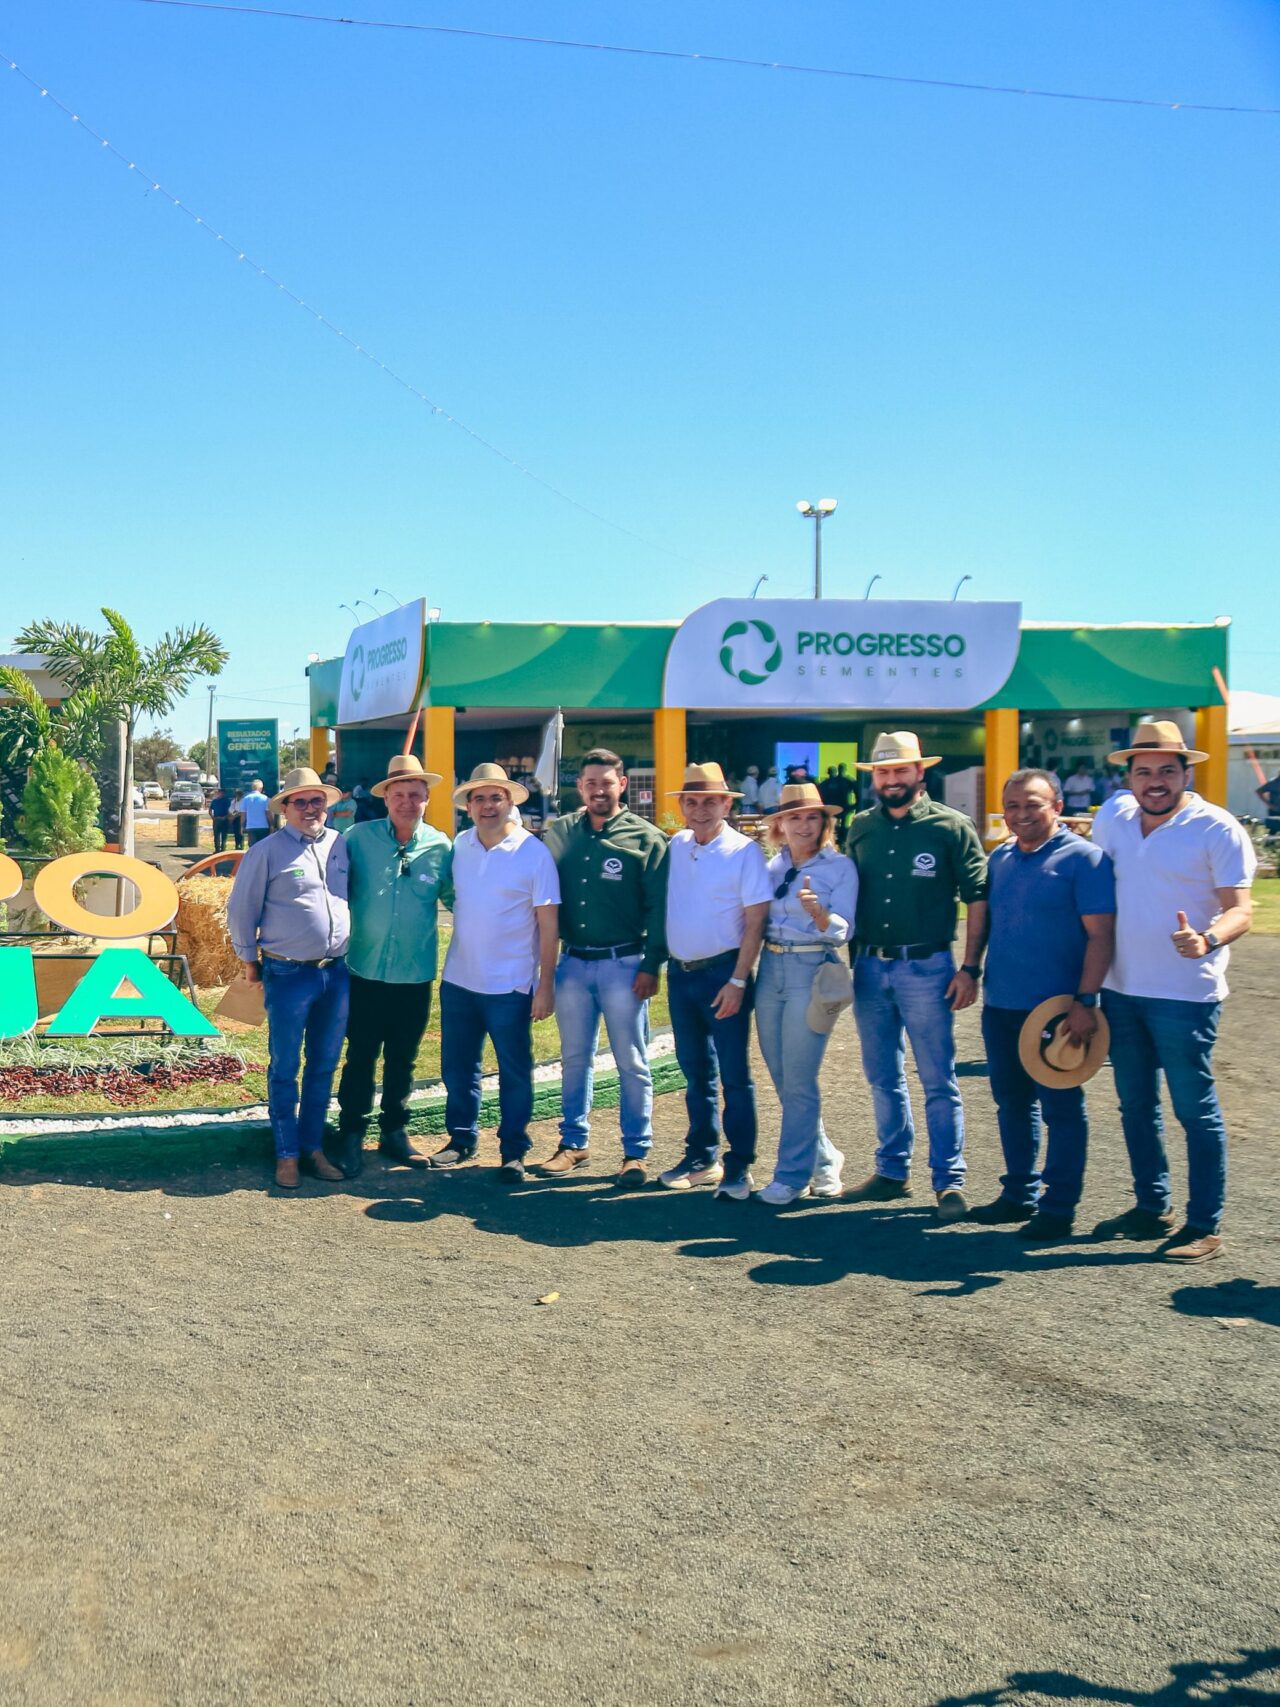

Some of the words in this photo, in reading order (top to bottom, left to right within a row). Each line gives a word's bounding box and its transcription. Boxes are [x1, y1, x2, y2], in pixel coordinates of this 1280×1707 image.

[367, 637, 407, 671] PROGRESSO
[797, 631, 966, 658] PROGRESSO
[798, 665, 964, 678] SEMENTES
